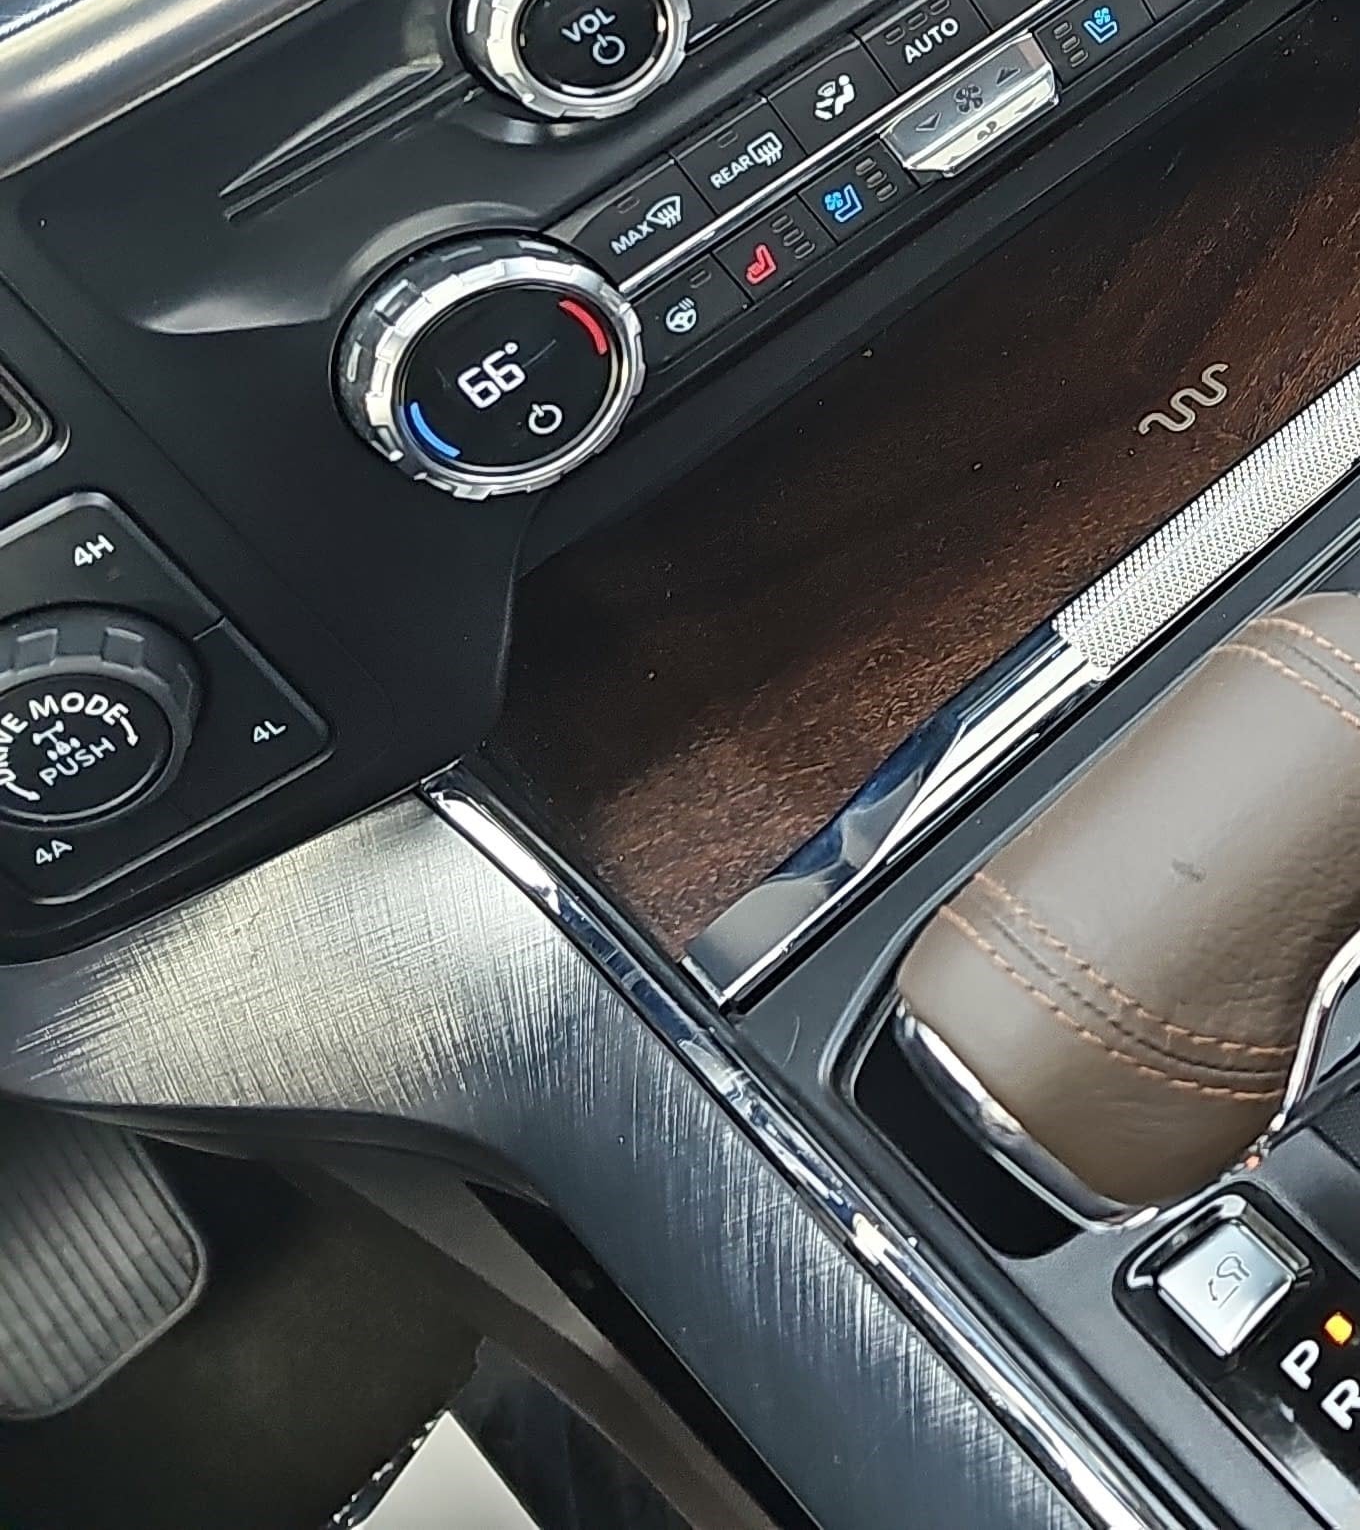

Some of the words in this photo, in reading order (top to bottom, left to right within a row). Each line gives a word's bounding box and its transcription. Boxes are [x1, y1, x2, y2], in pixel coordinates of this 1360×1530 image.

[562, 8, 616, 42] VOL
[903, 16, 960, 64] AUTO
[709, 155, 753, 190] REAR
[611, 220, 654, 255] MAX
[73, 534, 115, 569] 4H
[28, 691, 129, 727] MODE
[252, 720, 288, 745] 4L
[39, 736, 117, 787] PUSH
[34, 838, 74, 867] 4A
[1280, 1339, 1320, 1390] P
